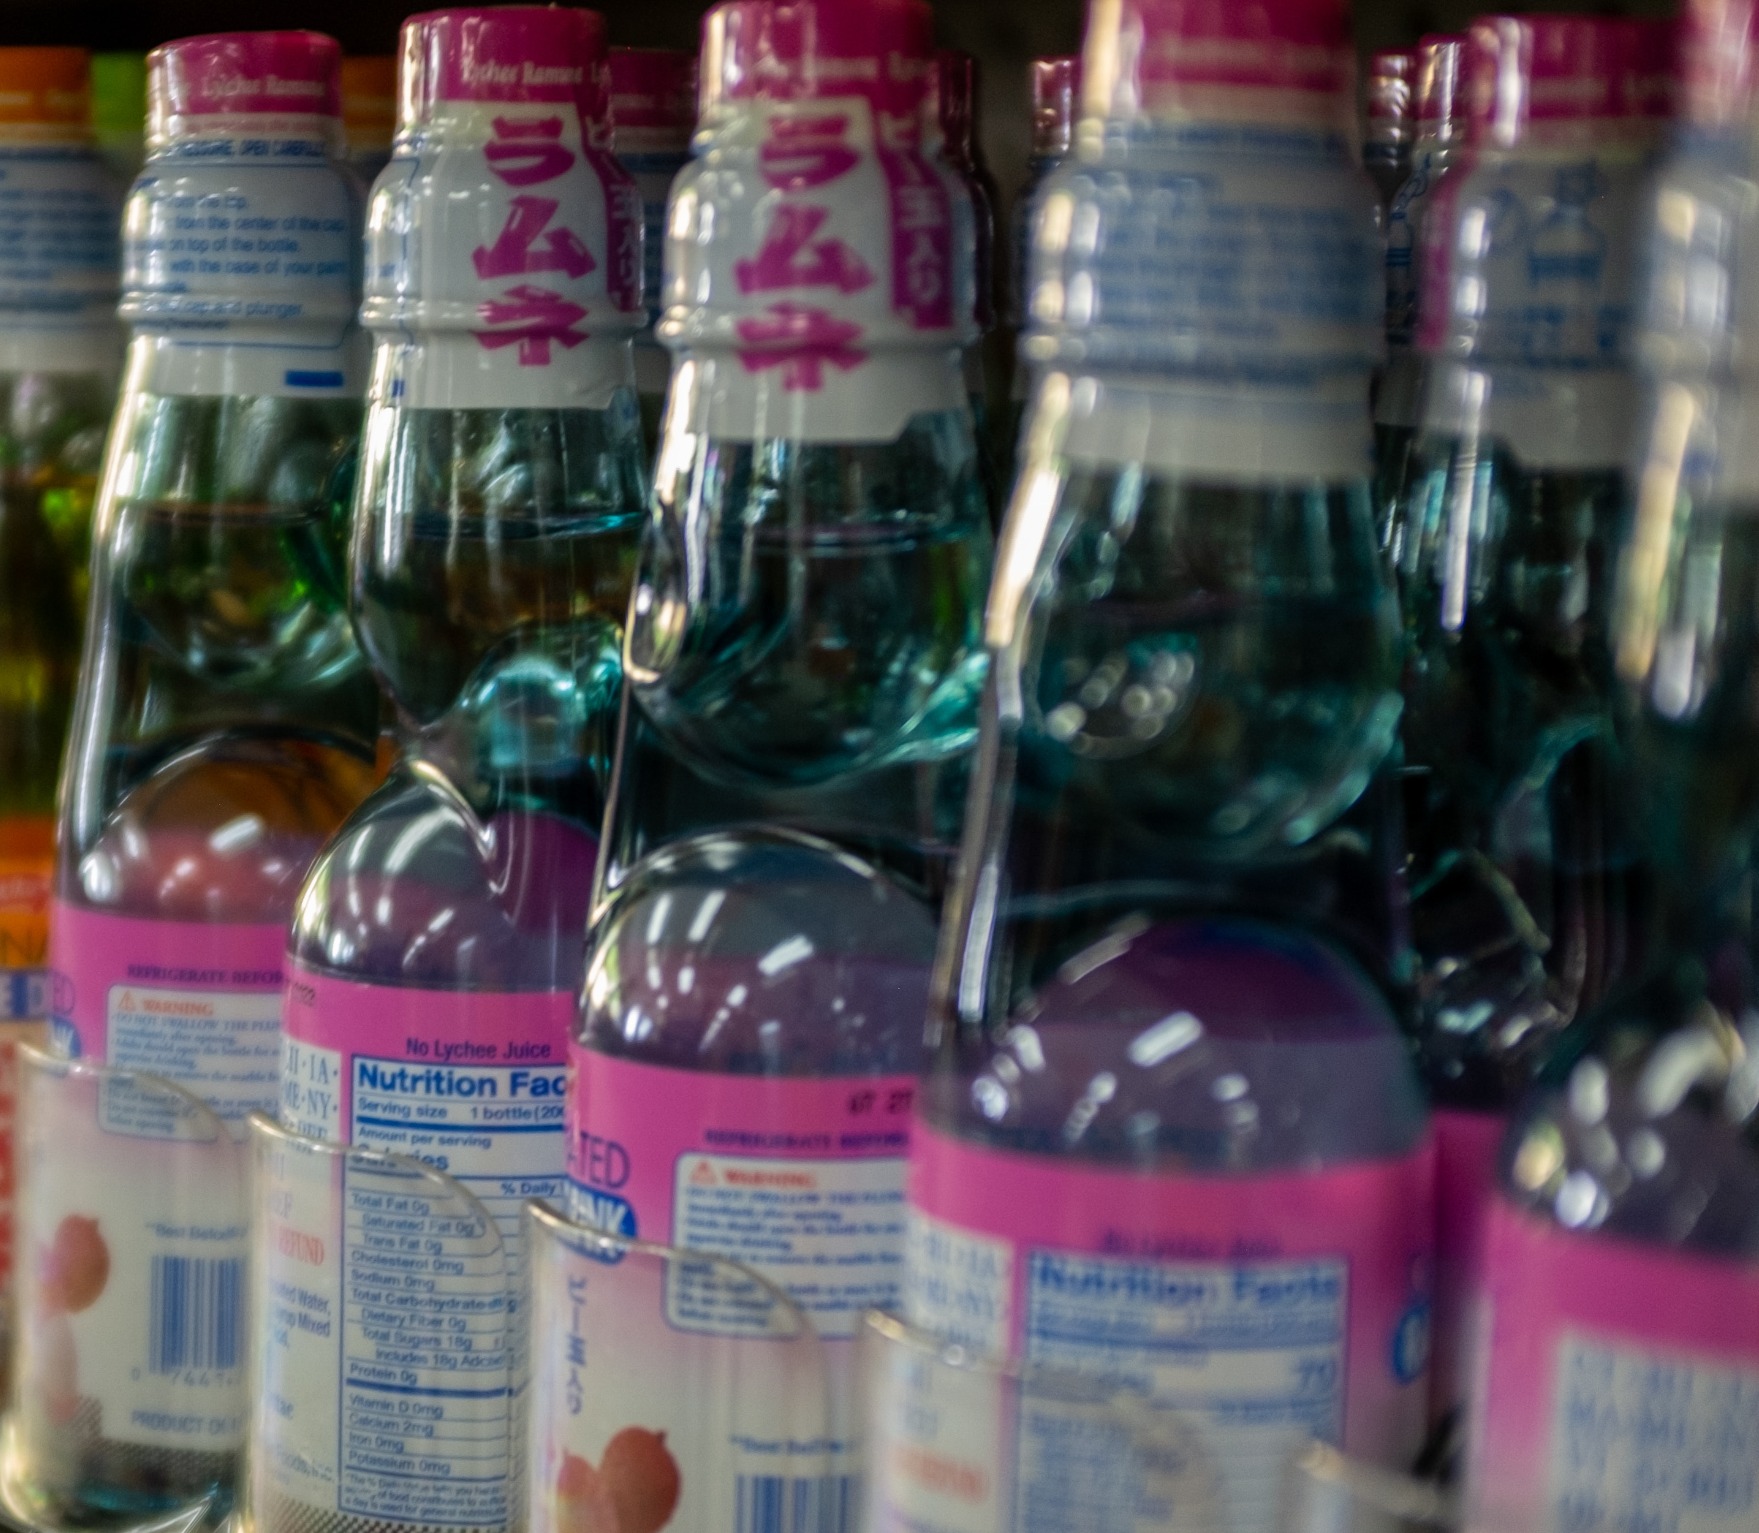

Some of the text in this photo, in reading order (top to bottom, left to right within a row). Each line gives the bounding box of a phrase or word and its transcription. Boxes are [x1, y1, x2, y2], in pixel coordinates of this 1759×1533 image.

[187, 236, 209, 254] top
[212, 236, 227, 251] of
[230, 237, 254, 251] the
[471, 114, 596, 368] ラムネ
[732, 113, 879, 394] ラムネ
[198, 259, 221, 274] the
[263, 259, 279, 274] of
[143, 999, 214, 1017] WARNING
[405, 1038, 552, 1062] No Lychee Juice
[357, 1062, 498, 1098] Nutrition
[357, 1096, 414, 1120] Serving
[416, 1103, 448, 1119] size
[470, 1106, 478, 1121] 1
[358, 1126, 492, 1150] Amount per serving
[500, 1182, 557, 1199] % Daily
[351, 1194, 430, 1217] Total Fat 0g
[363, 1212, 475, 1238] Saturated Fat 0g
[363, 1232, 443, 1256] Trans Fat 0g
[351, 1250, 465, 1275] Cholesterol 0mg
[351, 1268, 436, 1293] Sodium 0mg
[352, 1287, 382, 1303] Total
[361, 1307, 467, 1333] Dietary Fiber 0g
[362, 1326, 473, 1351] Total Sugars 18g
[375, 1348, 429, 1365] Includes
[433, 1351, 458, 1370] 18g
[350, 1362, 418, 1386] Protein 0g
[350, 1394, 444, 1420] Vitamin D 0mg
[350, 1413, 435, 1439] Calcium 2mg
[350, 1432, 405, 1455] Iron 0mg
[349, 1450, 416, 1472] Potassium
[418, 1455, 451, 1475] 0mg
